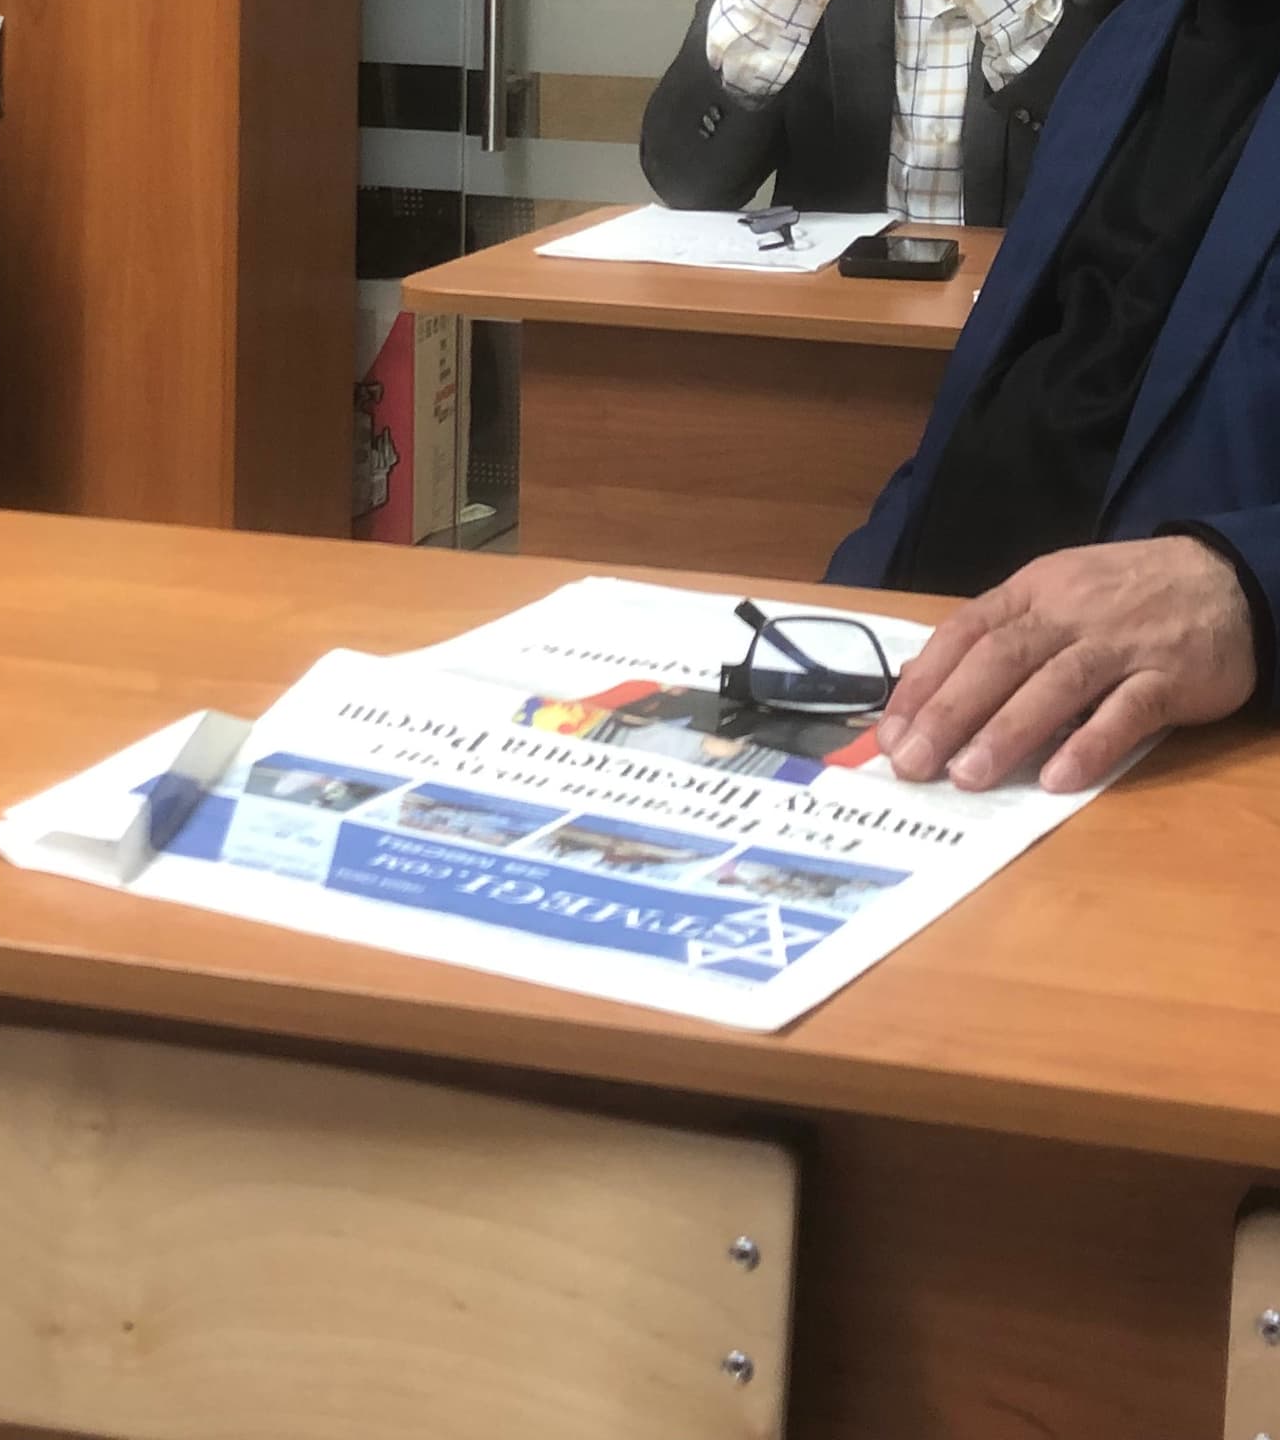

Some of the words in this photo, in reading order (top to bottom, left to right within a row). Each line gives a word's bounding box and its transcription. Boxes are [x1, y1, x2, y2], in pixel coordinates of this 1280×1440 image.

[336, 701, 489, 753] России
[501, 737, 762, 809] Президента
[775, 792, 965, 845] награду
